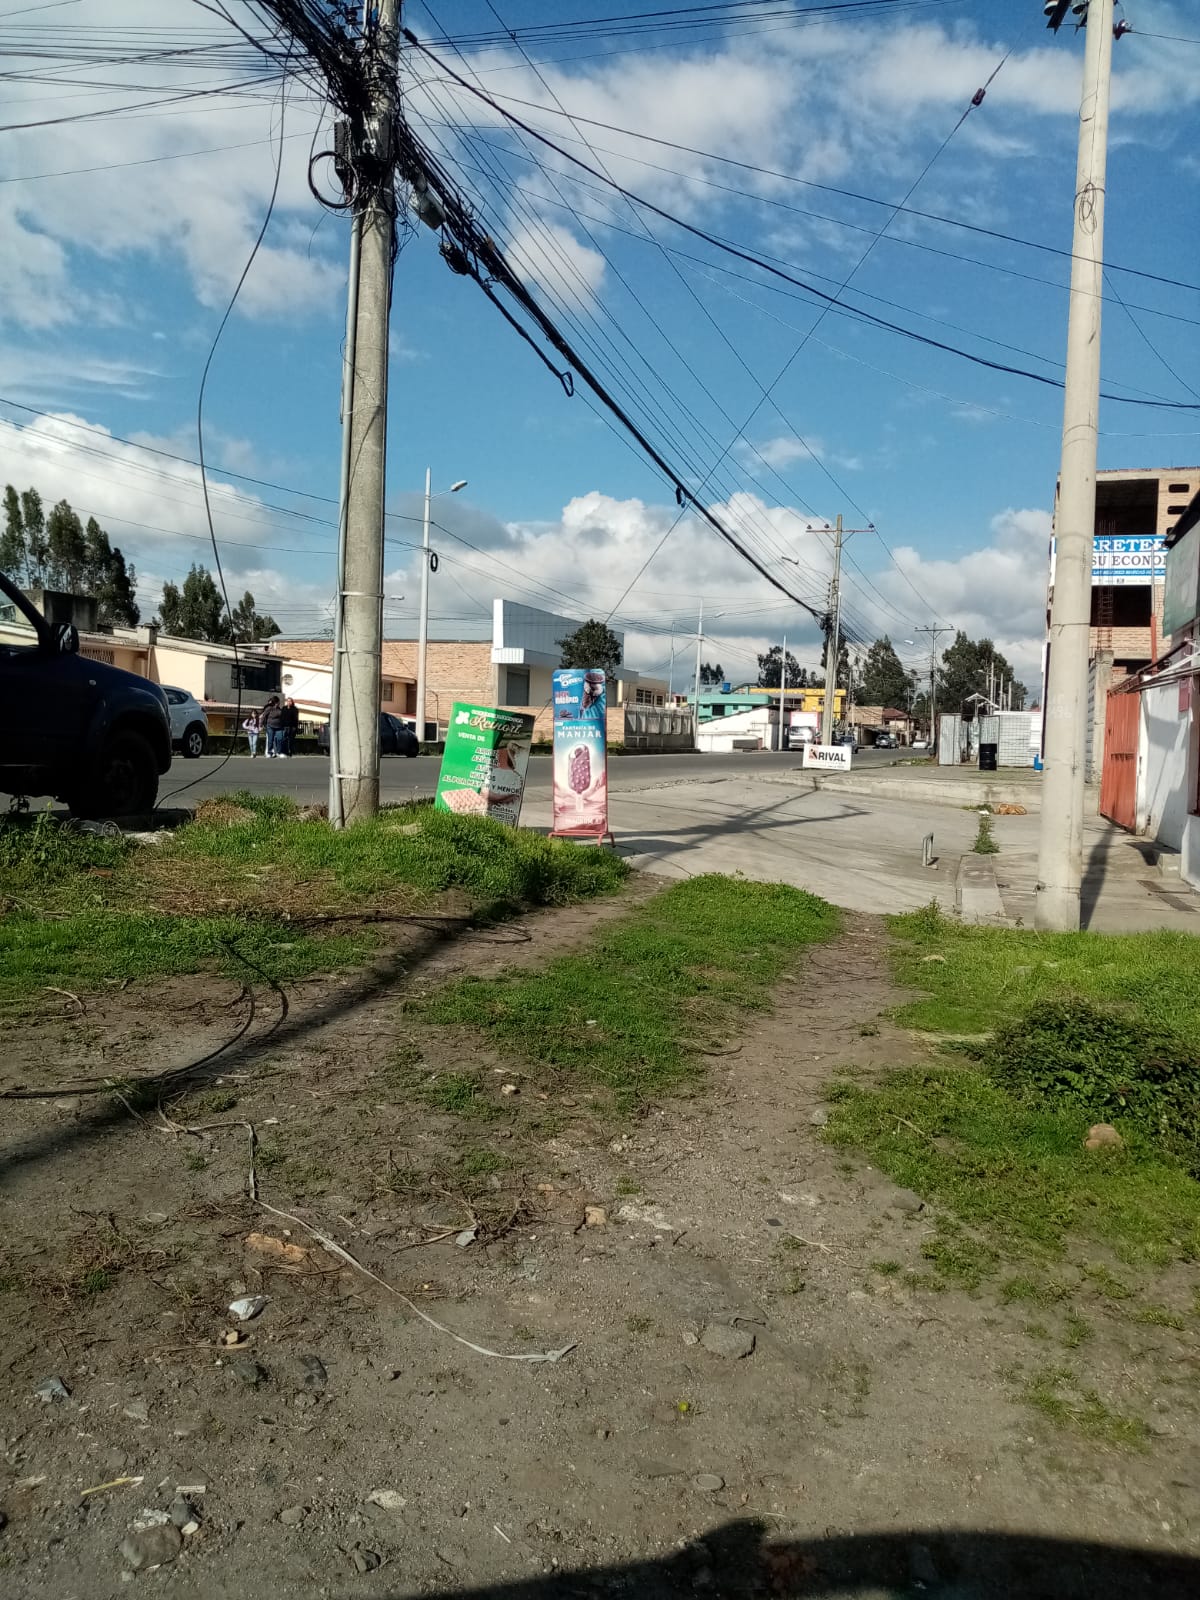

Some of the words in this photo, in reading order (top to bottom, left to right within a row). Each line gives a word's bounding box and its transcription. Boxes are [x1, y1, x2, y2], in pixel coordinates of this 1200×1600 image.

[1112, 555, 1166, 566] ECONO
[458, 732, 476, 740] VENTA
[557, 730, 602, 738] MANJAR
[818, 751, 846, 762] RIVAL
[497, 784, 520, 795] MENOR
